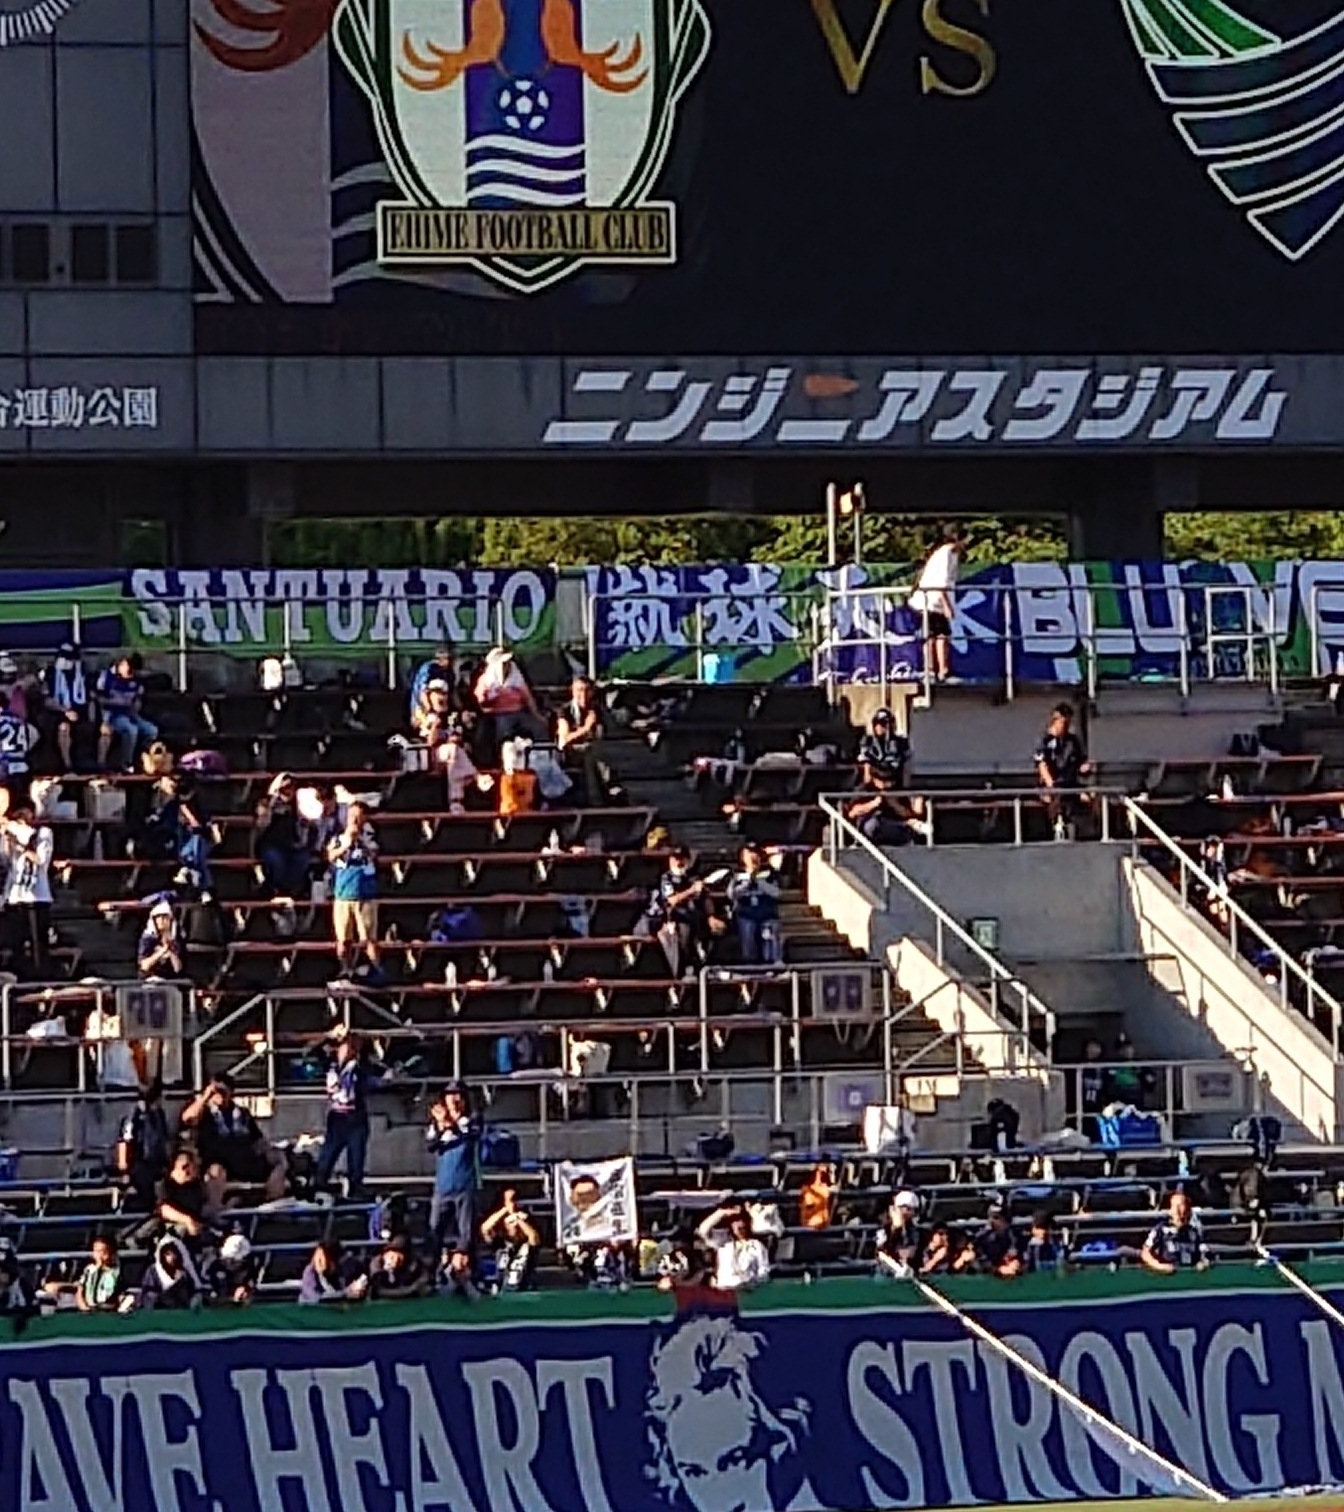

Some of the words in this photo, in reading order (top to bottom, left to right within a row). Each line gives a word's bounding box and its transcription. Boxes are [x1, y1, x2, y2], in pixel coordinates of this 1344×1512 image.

[389, 212, 469, 250] EHIME
[474, 212, 599, 251] FOOTBALL
[603, 212, 666, 252] CLUB
[542, 367, 1288, 443] ニンジニアスタジアム
[130, 568, 550, 643] SANTUARIO
[230, 1356, 617, 1512] HEART
[847, 1321, 1282, 1508] STRONG
